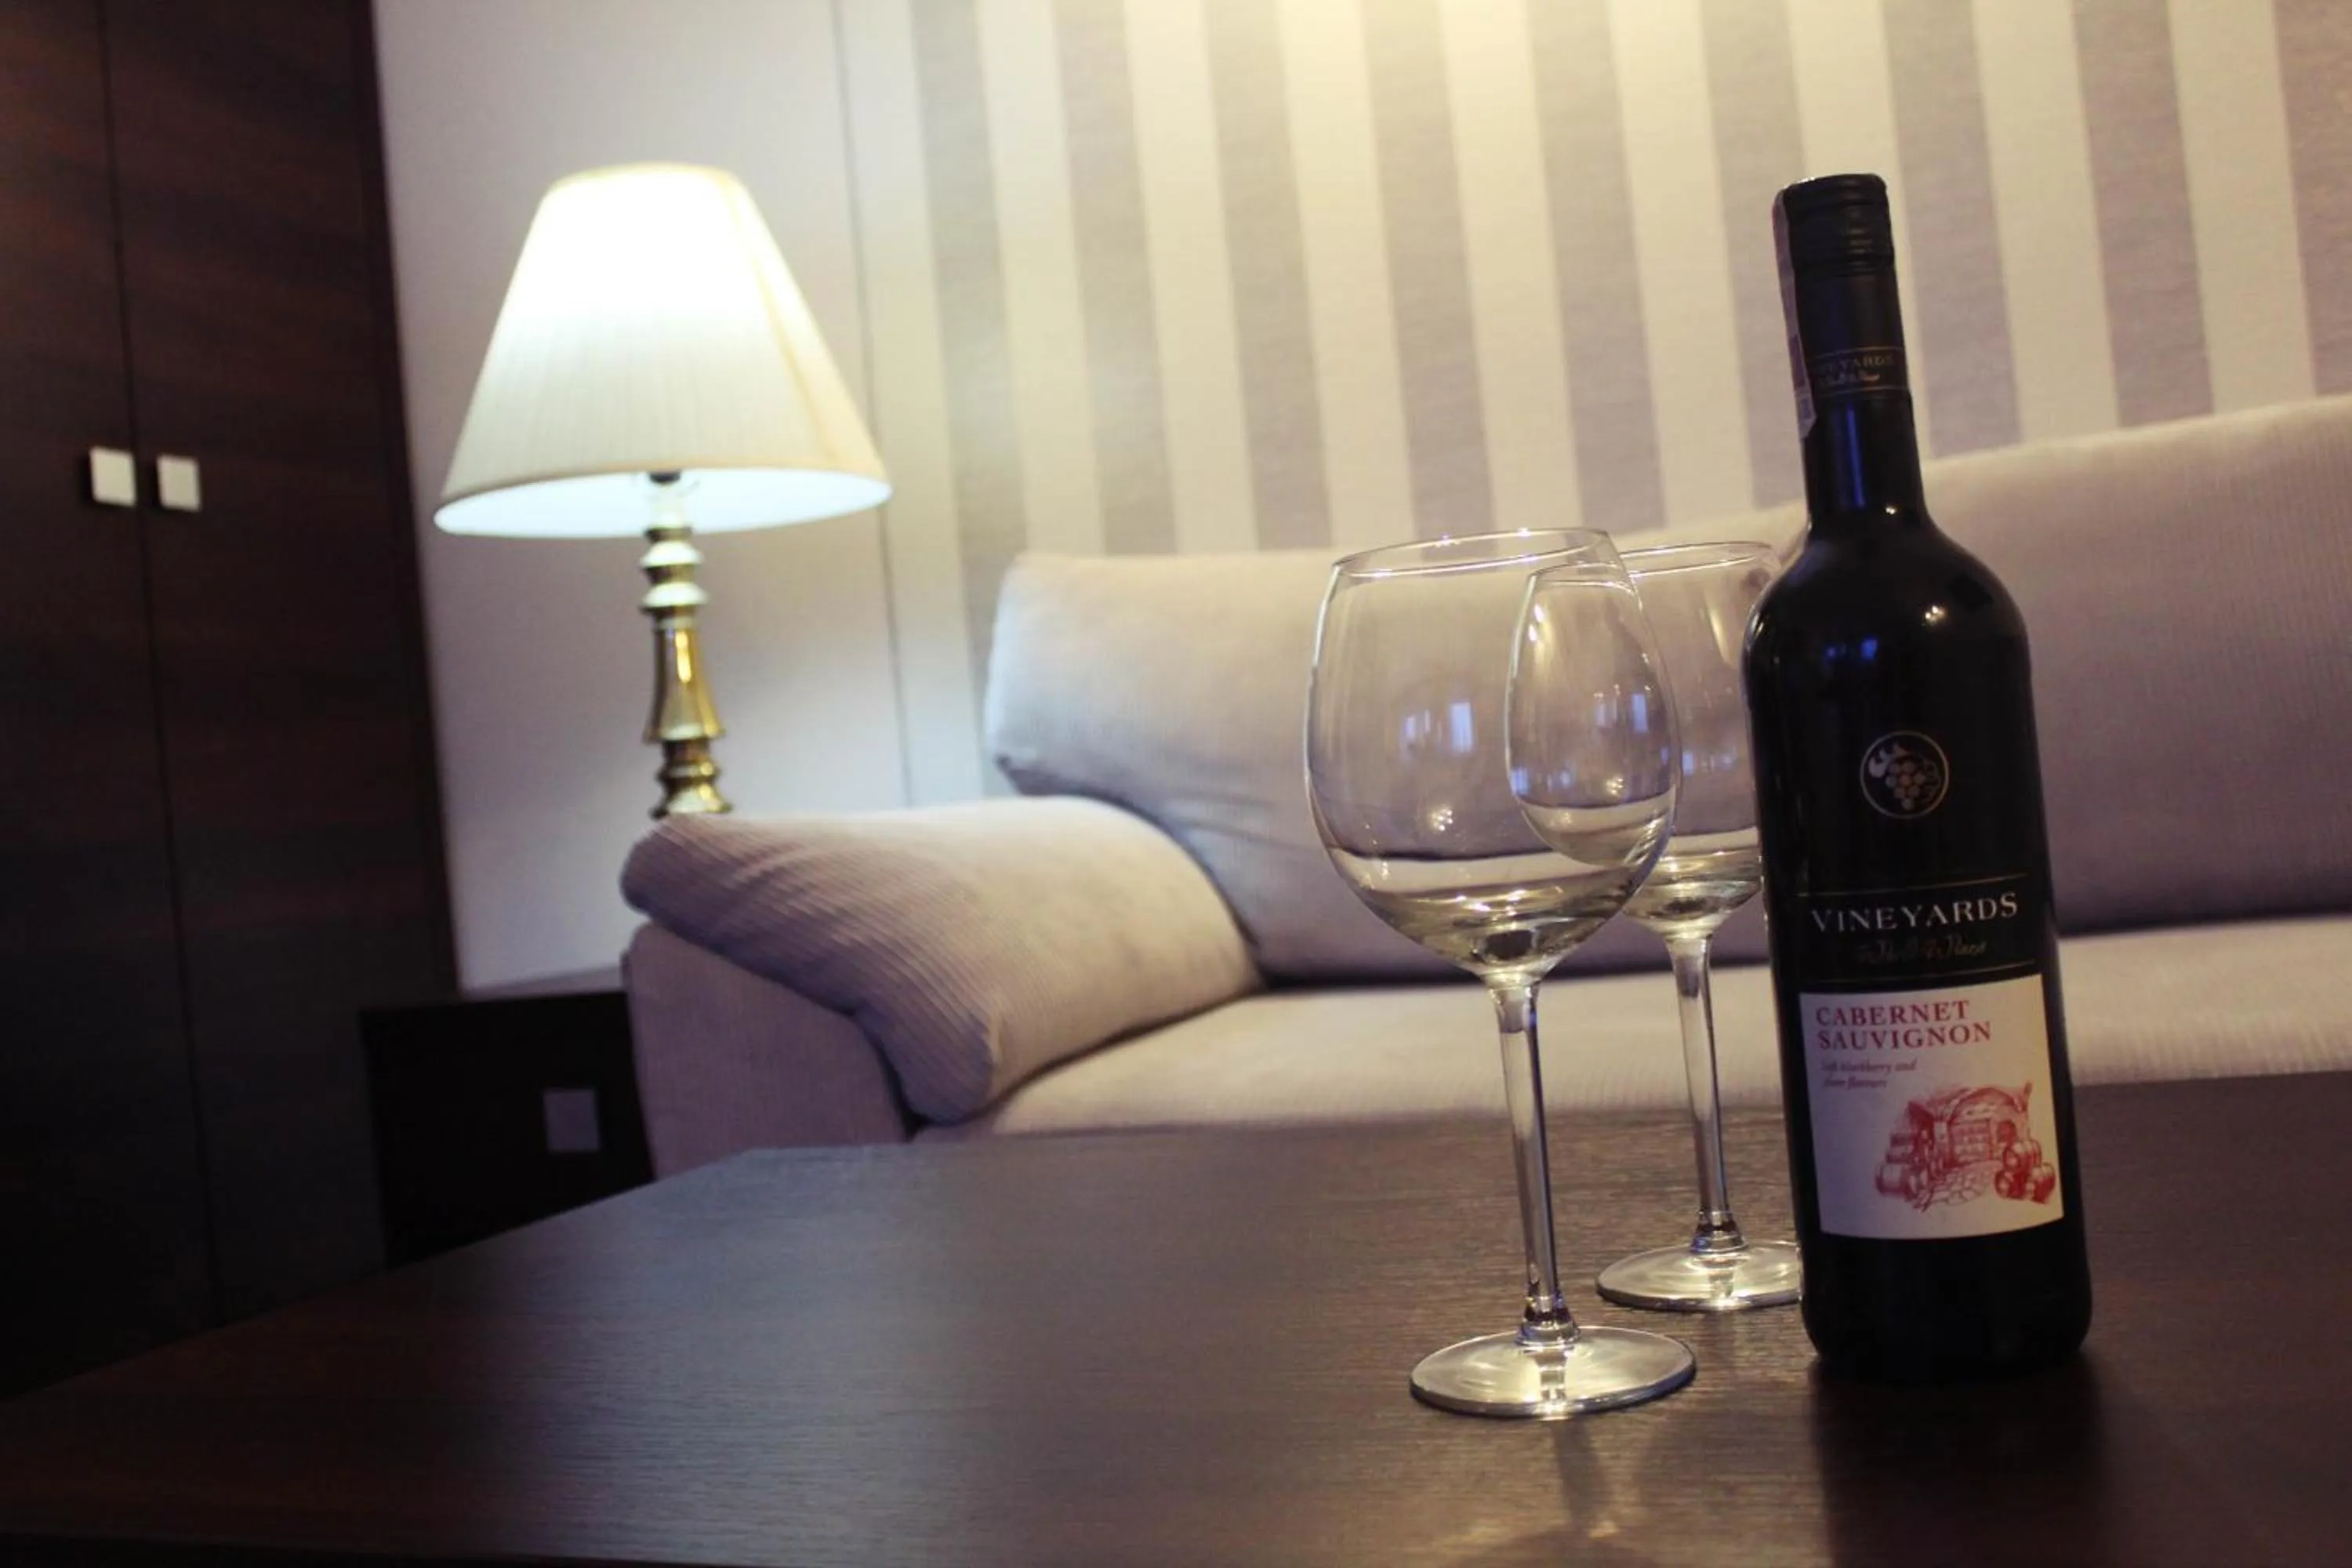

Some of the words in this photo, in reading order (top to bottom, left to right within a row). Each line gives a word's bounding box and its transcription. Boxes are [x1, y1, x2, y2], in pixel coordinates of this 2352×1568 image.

[1810, 891, 2018, 933] VINEYARDS
[1815, 1000, 1969, 1026] CABERNET
[1817, 1022, 1991, 1051] SAUVIGNON
